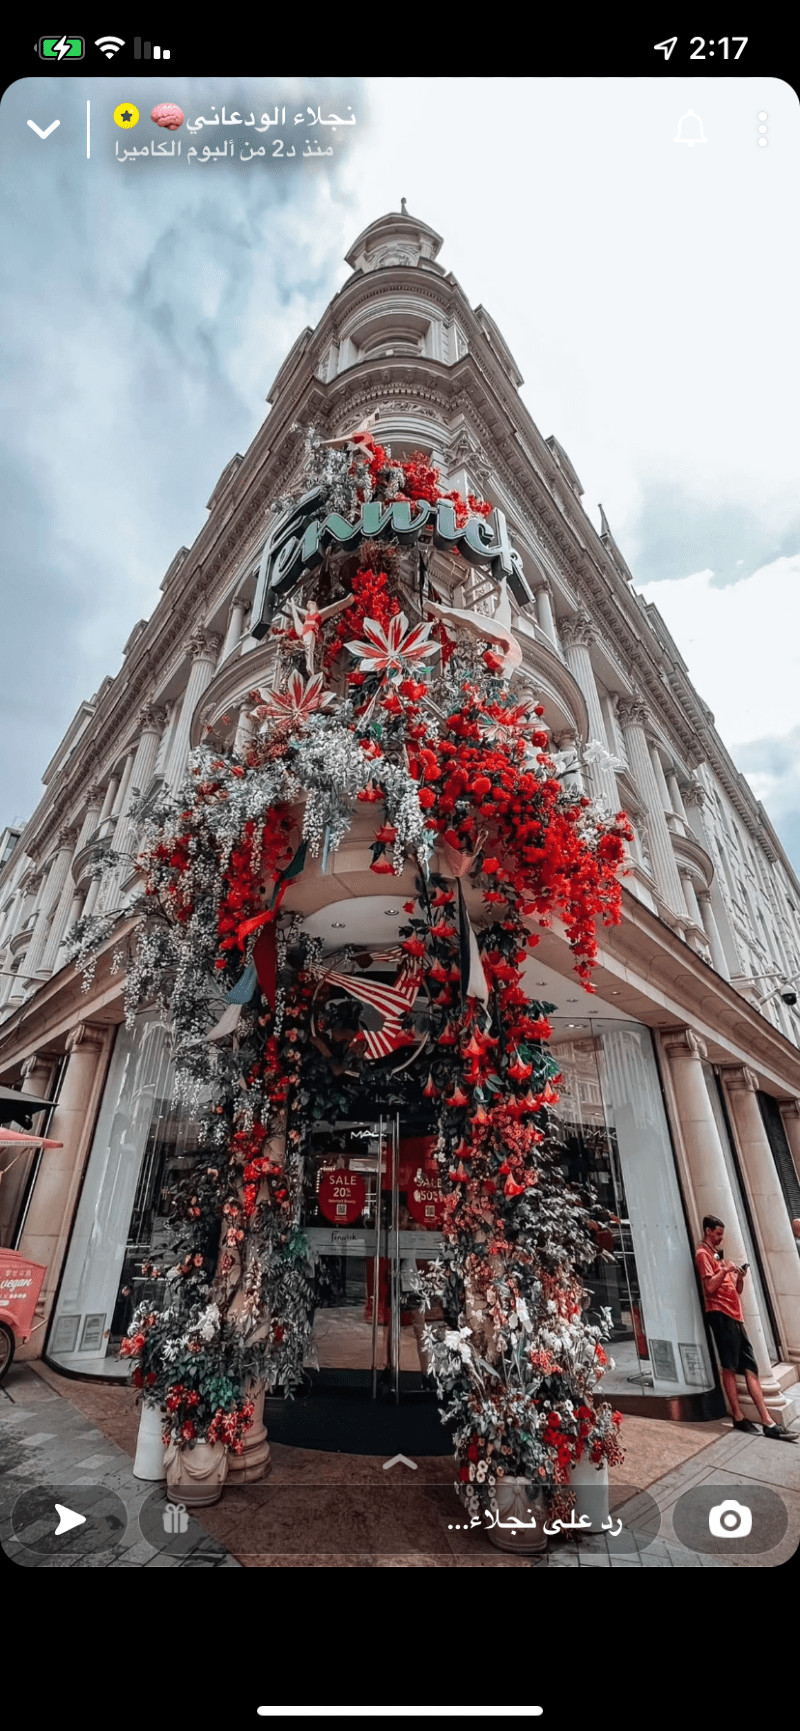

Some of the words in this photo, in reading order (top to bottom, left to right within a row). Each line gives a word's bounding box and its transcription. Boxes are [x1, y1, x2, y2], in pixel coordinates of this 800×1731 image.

[250, 485, 536, 638] Fenwick
[329, 1175, 357, 1186] SALE
[416, 1177, 442, 1188] SALE
